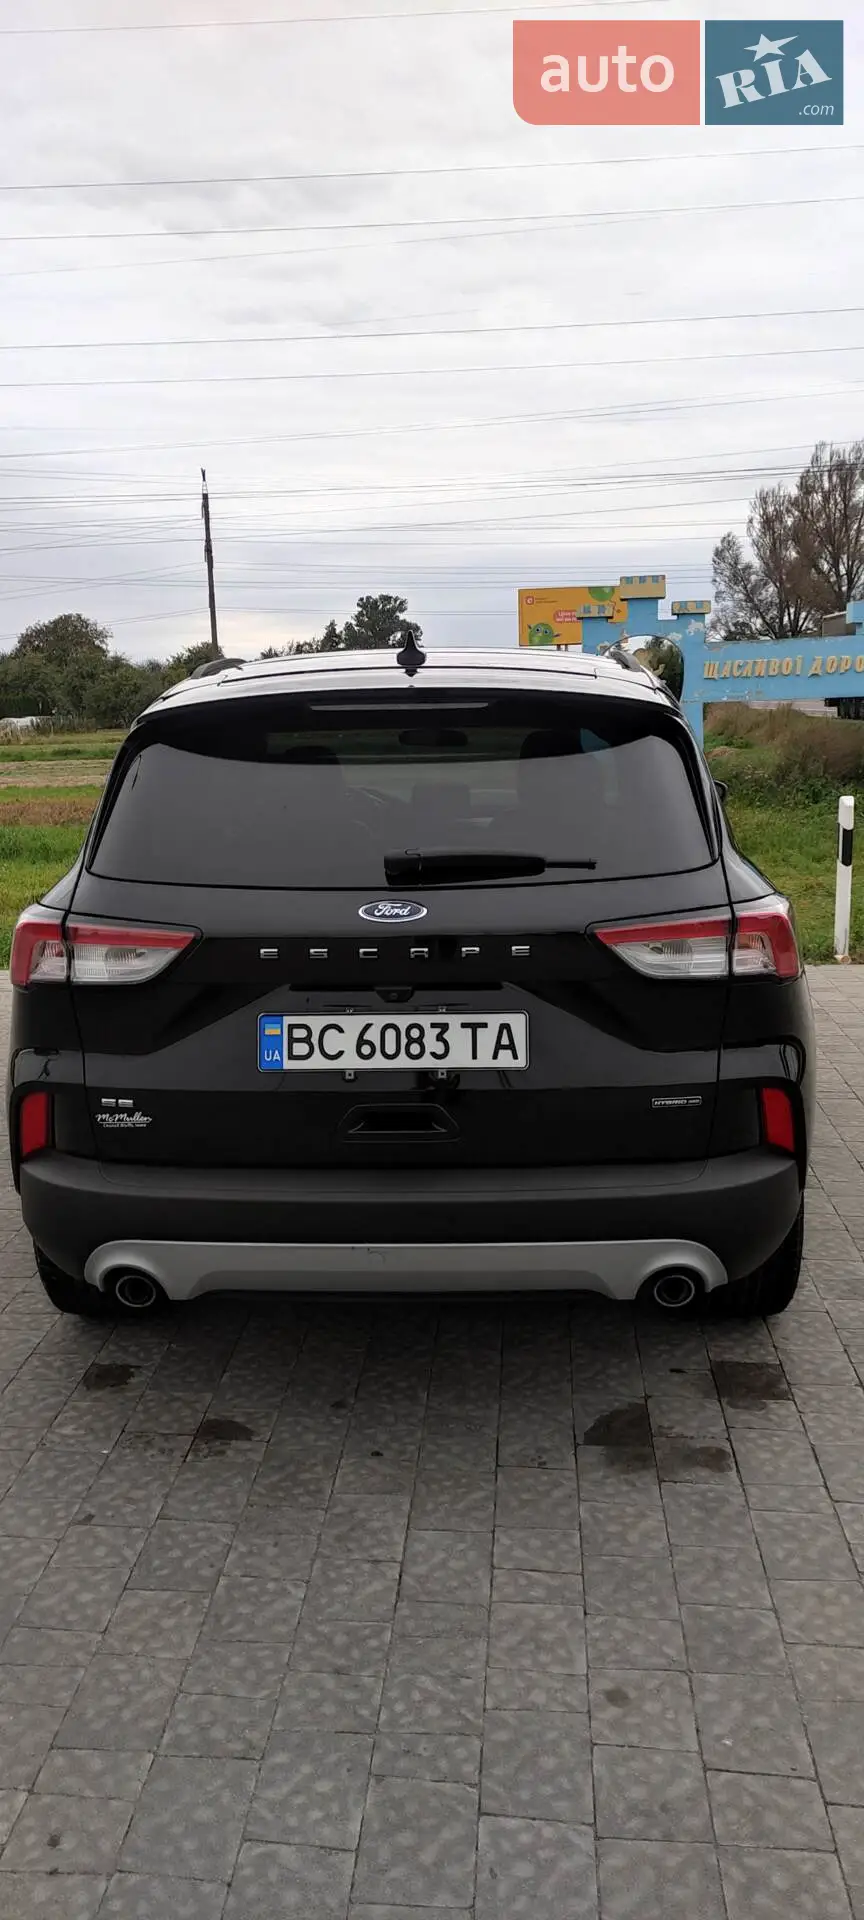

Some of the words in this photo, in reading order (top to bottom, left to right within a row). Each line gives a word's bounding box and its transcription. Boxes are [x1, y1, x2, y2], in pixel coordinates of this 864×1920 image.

[703, 655, 804, 680] ЩАСЛИВОЇ
[374, 903, 411, 918] Ford
[260, 945, 531, 960] ESCAPE
[287, 1022, 345, 1061] BC
[355, 1022, 450, 1061] 6083
[460, 1022, 519, 1061] TA
[264, 1049, 281, 1062] UA
[95, 1112, 152, 1122] McMullen
